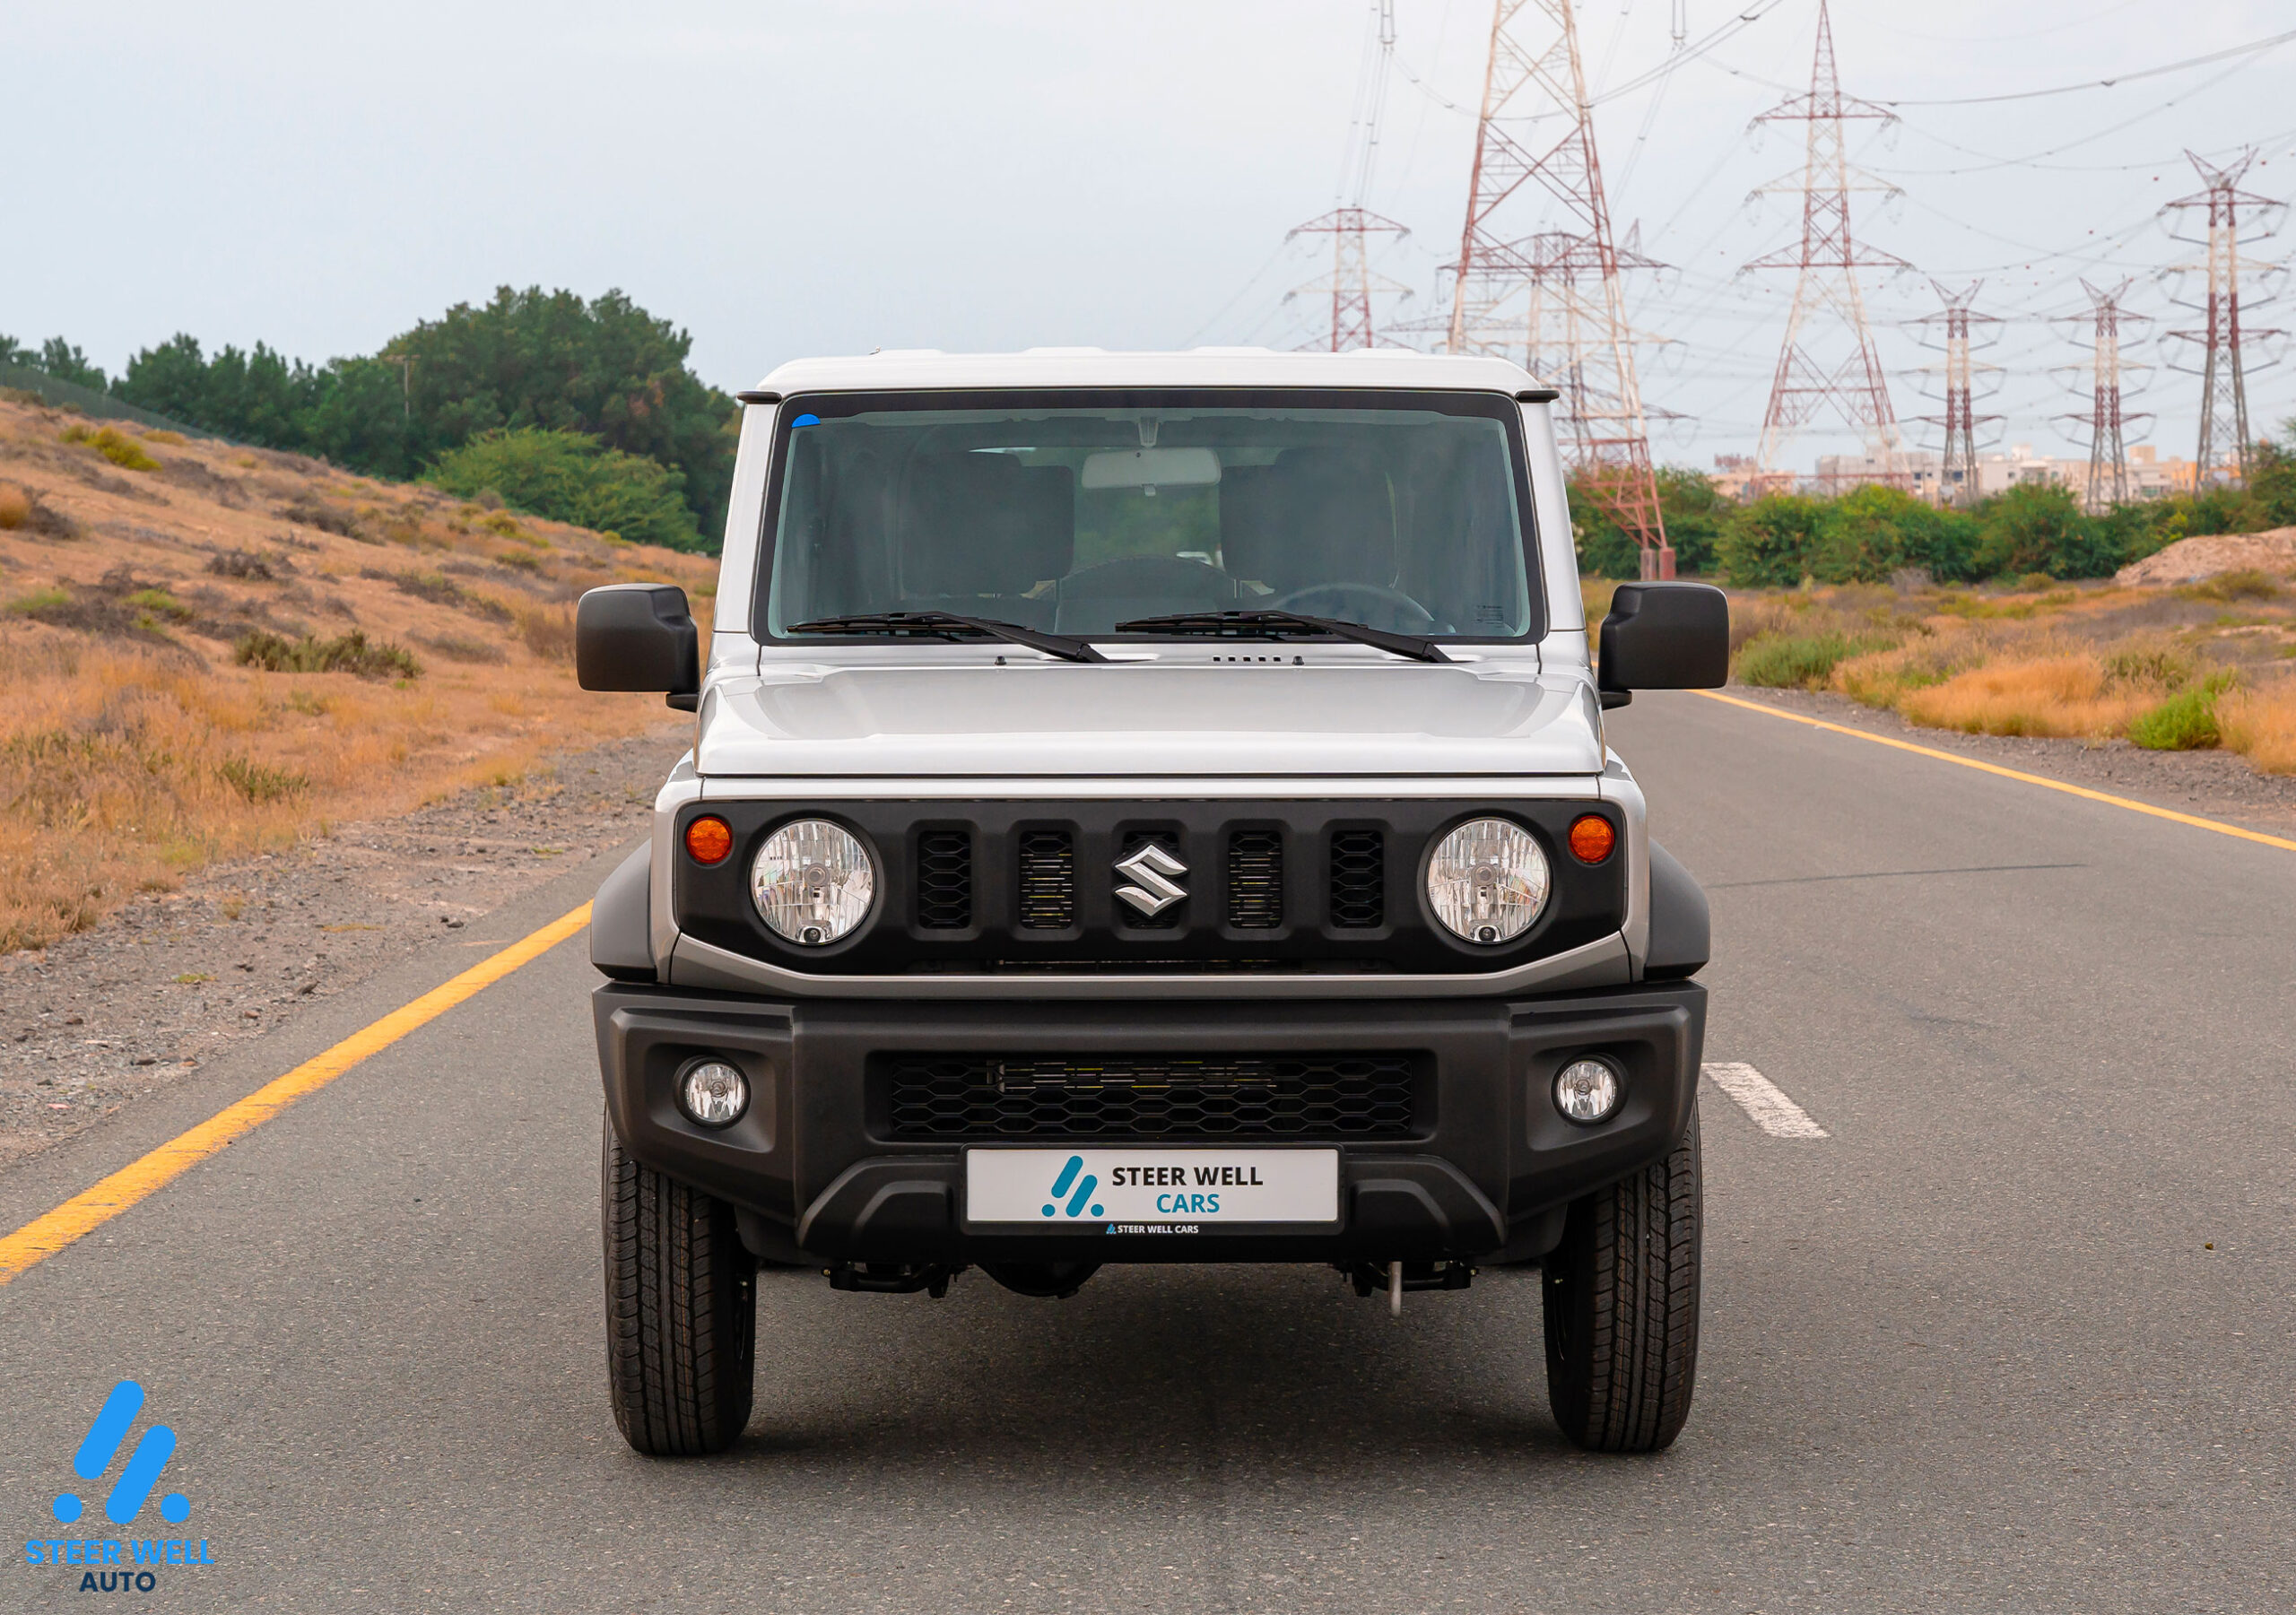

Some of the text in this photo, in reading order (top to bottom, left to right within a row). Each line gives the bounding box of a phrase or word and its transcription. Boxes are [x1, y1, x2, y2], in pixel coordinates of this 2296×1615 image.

[1112, 1167, 1264, 1186] STEER WELL
[1156, 1194, 1220, 1213] CARS
[1118, 1225, 1199, 1234] STEER WELL CARS
